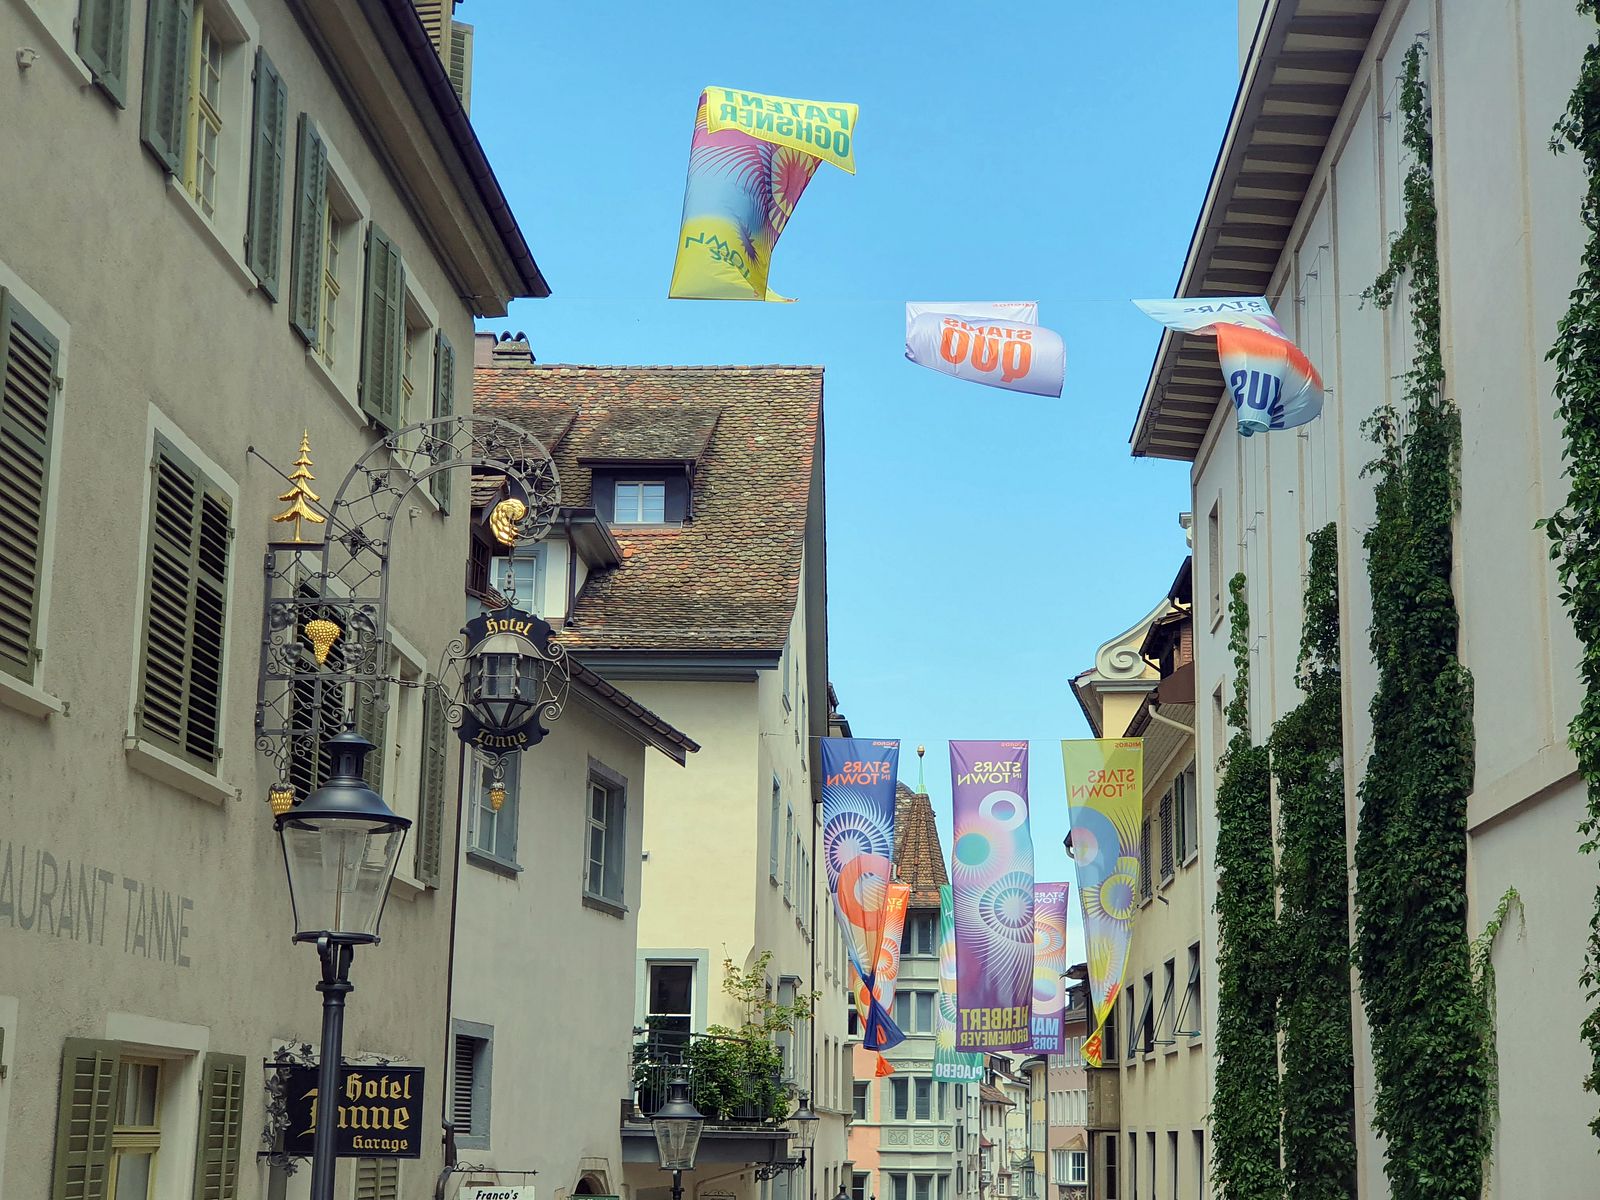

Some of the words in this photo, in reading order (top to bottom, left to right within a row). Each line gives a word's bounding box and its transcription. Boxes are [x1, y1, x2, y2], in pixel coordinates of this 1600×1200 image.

[485, 618, 533, 637] Hotel
[473, 729, 528, 747] Tanne
[123, 877, 194, 969] TANNE
[346, 1072, 412, 1103] Hotel
[352, 1135, 408, 1153] Garage
[475, 1189, 519, 1200] Franco's
